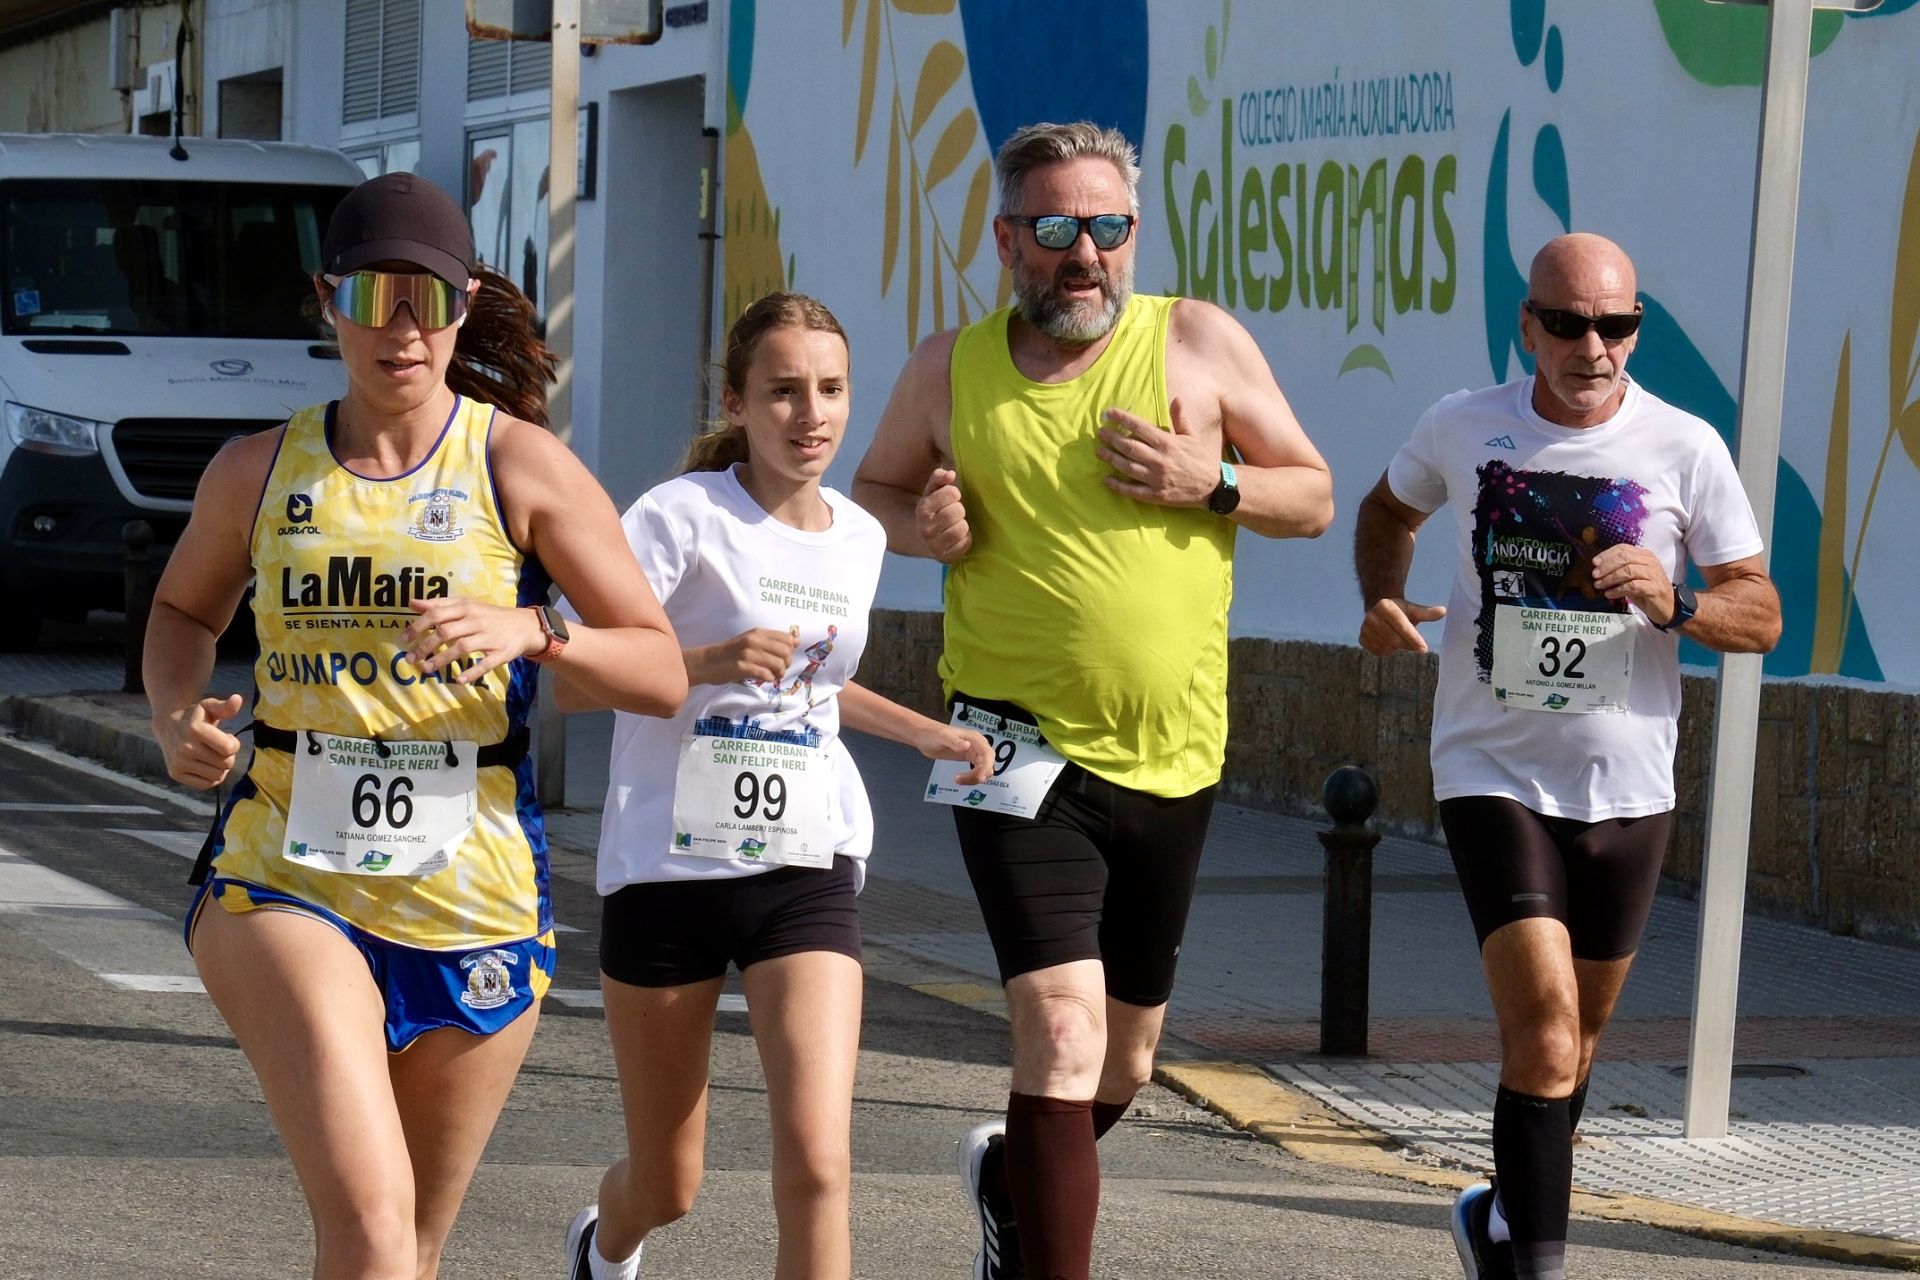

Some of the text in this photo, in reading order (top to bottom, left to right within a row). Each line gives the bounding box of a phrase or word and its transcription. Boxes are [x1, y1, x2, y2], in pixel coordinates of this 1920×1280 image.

[1239, 66, 1455, 146] COLEGIO MARÍA AUXILIADORA
[1164, 98, 1457, 336] Salesianas
[759, 577, 850, 605] CARRERA URBANA
[760, 591, 848, 617] SAN FELIPE NERI
[285, 620, 301, 630] SE
[306, 620, 360, 630] SIENTA
[365, 620, 375, 629] A
[380, 620, 399, 629] LA
[1520, 609, 1611, 624] CARRERA URBANA
[1522, 621, 1607, 635] SAN FELIPE NERI
[1539, 636, 1587, 679] 32
[1525, 679, 1550, 687] ANTONIO
[968, 708, 1001, 726] CARRER
[327, 738, 446, 756] CARRER URBANA
[711, 739, 809, 758] CARRERA URBANA
[329, 753, 439, 770] SAN FELIPE NERI
[713, 753, 806, 771] SAN FELIPE NERI
[352, 774, 414, 829] 66
[733, 771, 787, 821] 99
[336, 831, 365, 841] TATIANA
[715, 821, 798, 835] CARLA LAMBERT ESPINOSA
